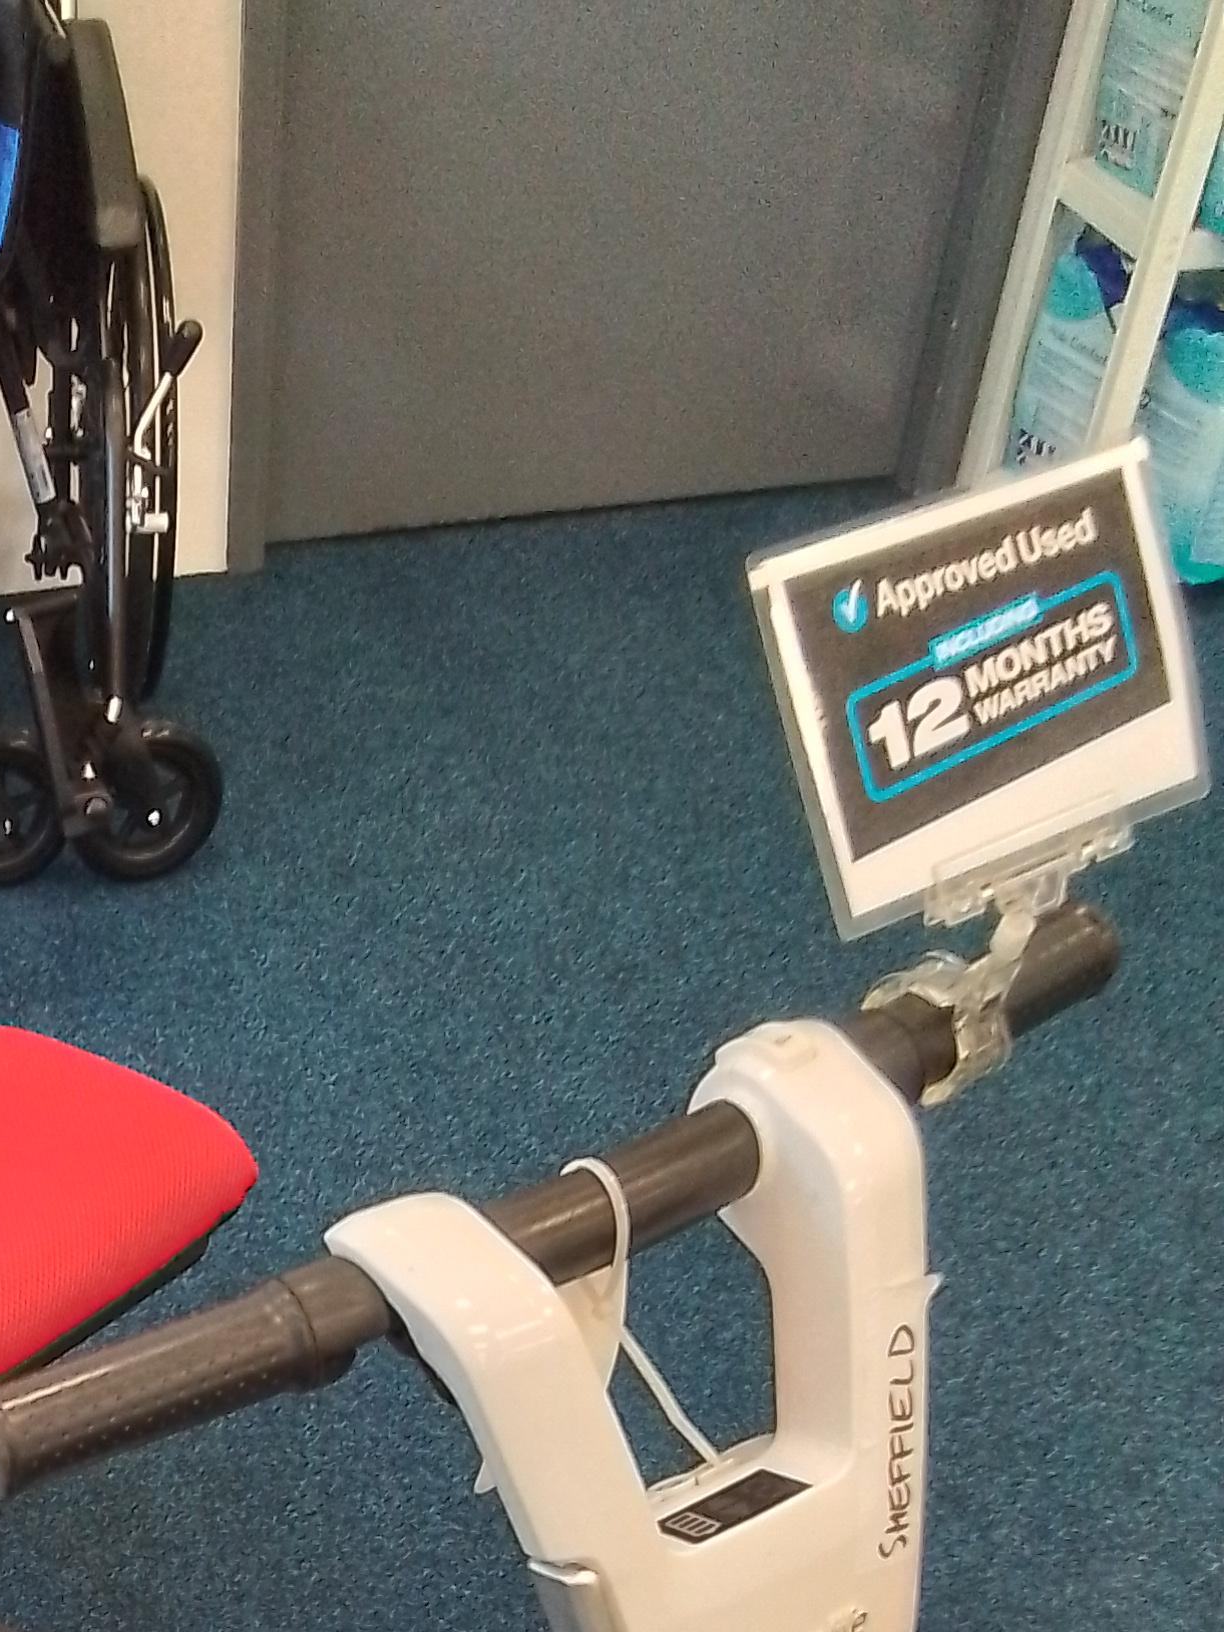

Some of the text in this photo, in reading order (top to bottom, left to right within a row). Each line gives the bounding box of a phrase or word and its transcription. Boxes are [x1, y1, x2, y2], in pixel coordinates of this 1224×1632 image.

[875, 507, 1098, 618] Approved Used
[963, 602, 1114, 697] MONTHS
[971, 637, 1117, 725] WARRANTY
[867, 676, 971, 770] 12
[877, 1322, 915, 1560] SHEFFIELD
